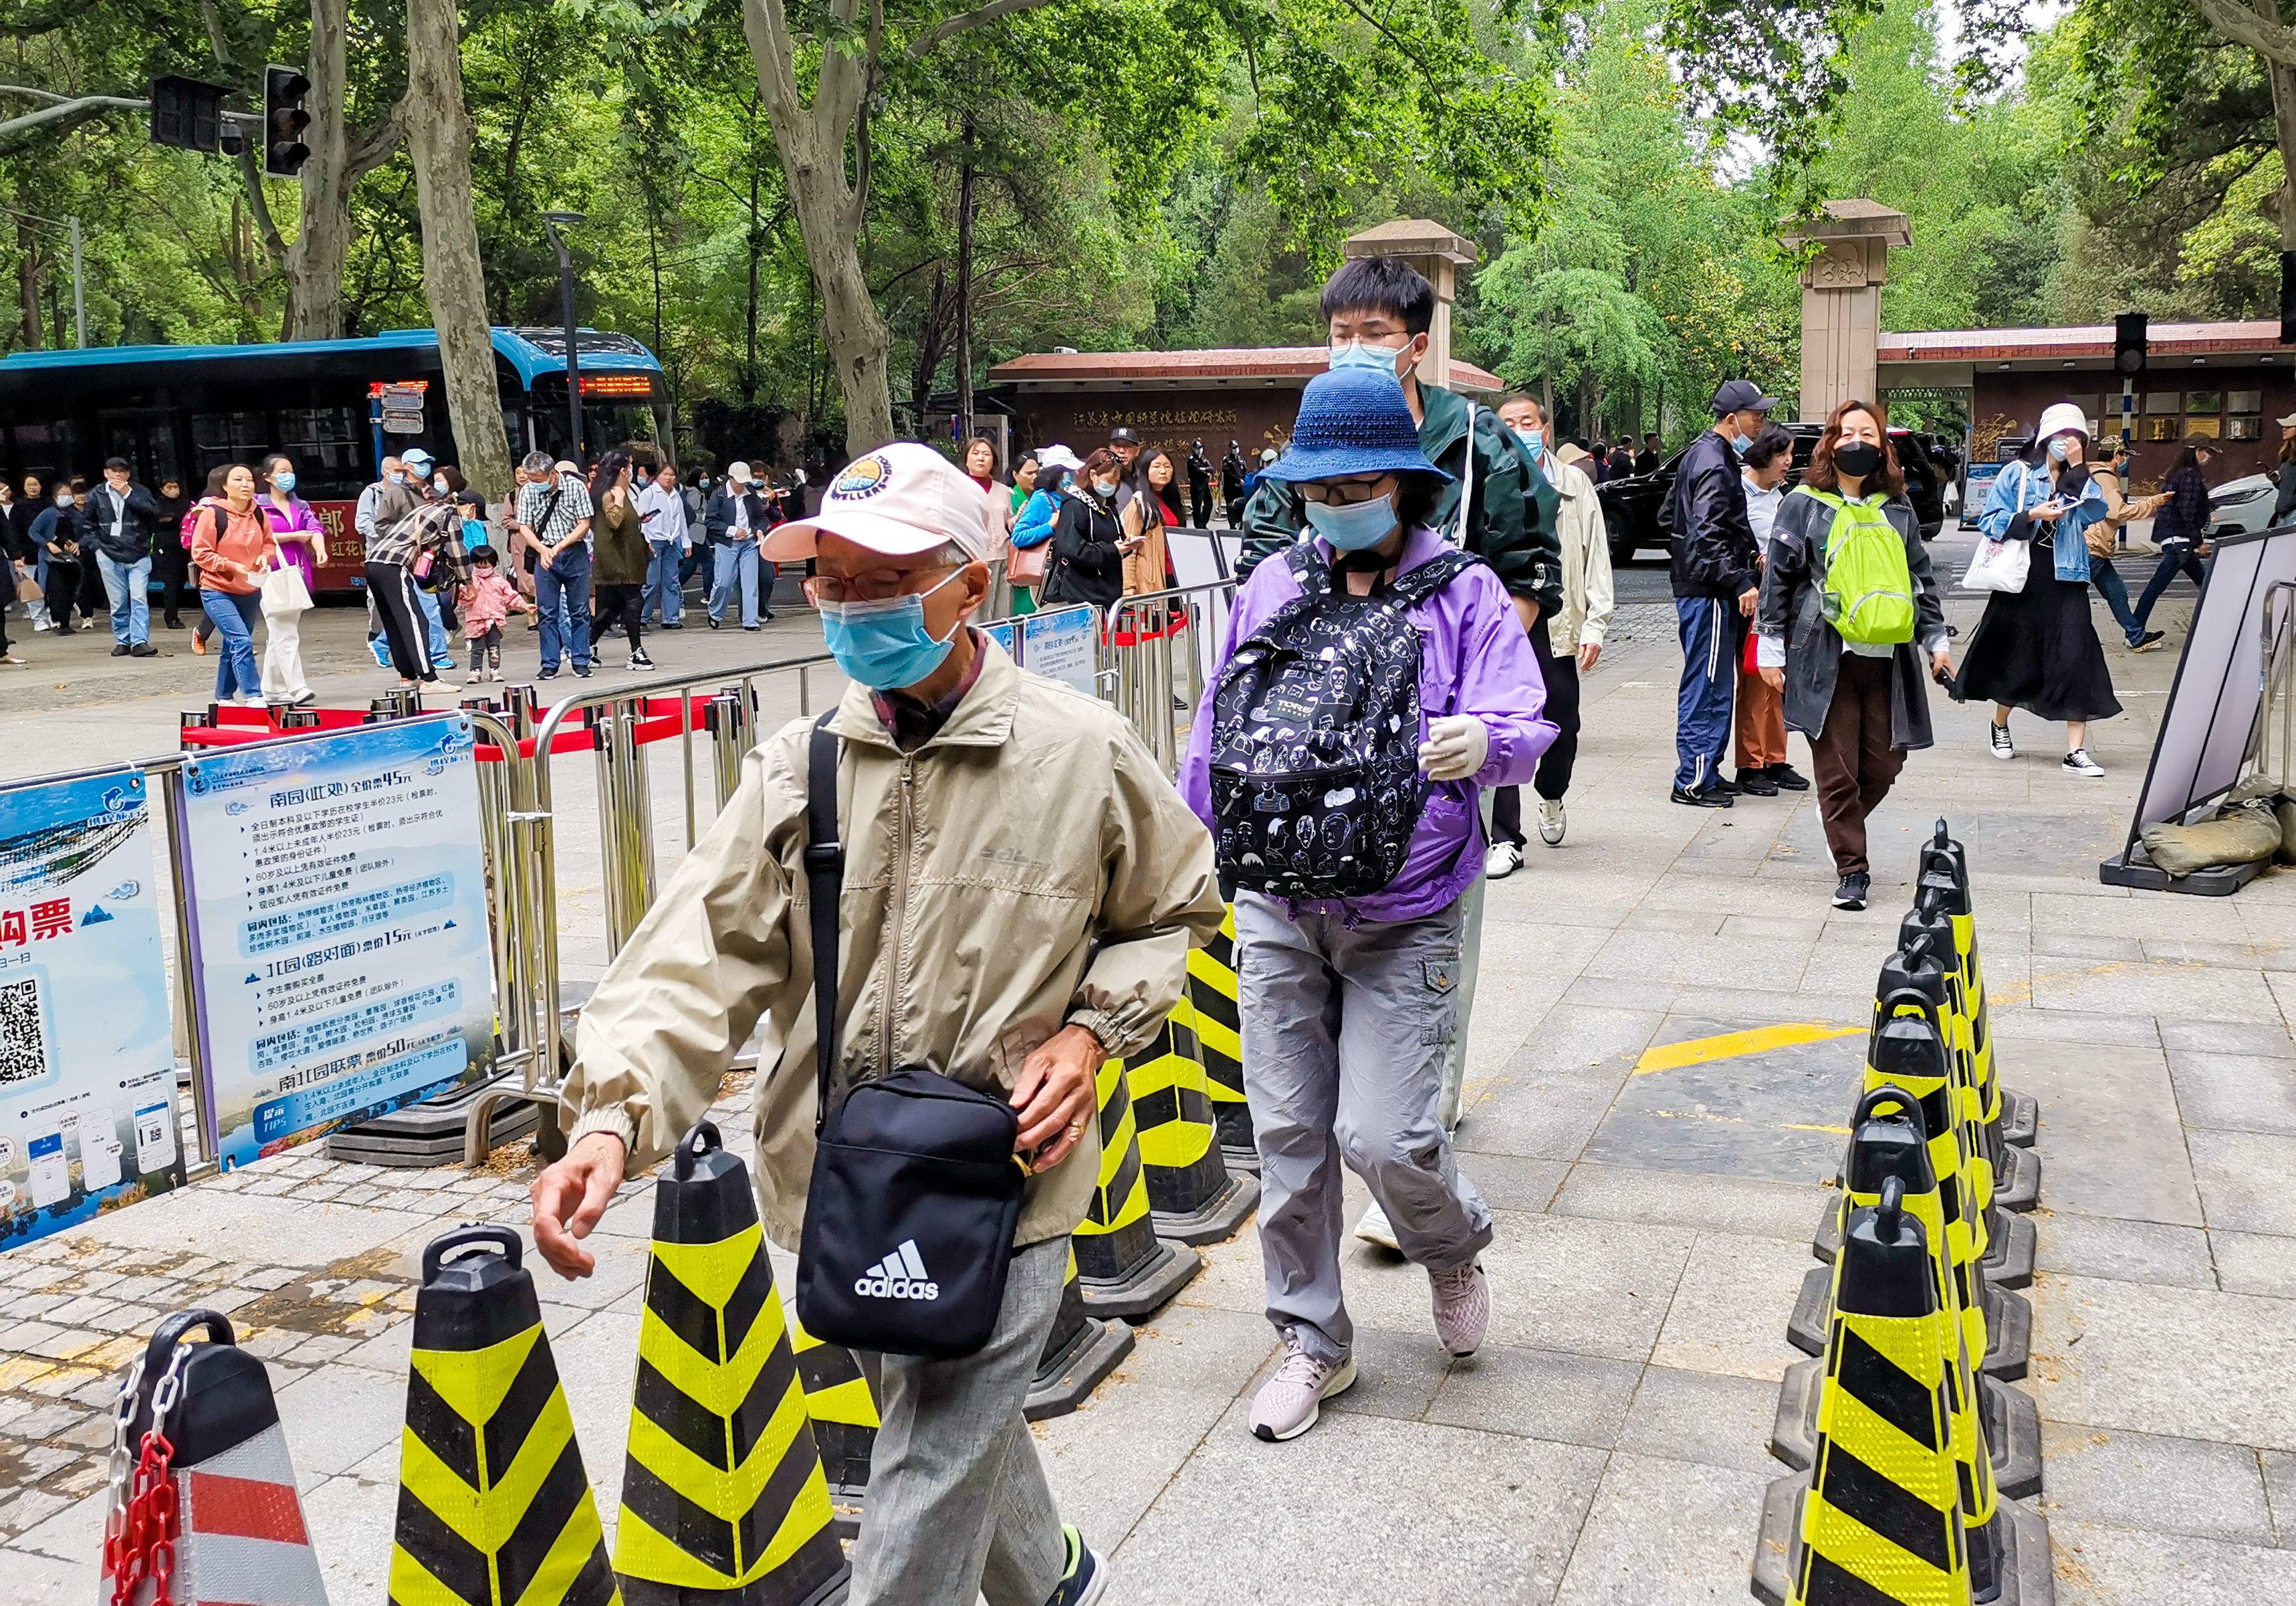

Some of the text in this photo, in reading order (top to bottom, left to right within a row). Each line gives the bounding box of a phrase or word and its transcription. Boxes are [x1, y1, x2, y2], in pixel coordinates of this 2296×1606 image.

[319, 507, 345, 538] 郎
[264, 1117, 288, 1133] TIPS
[854, 1276, 939, 1300] adidas
